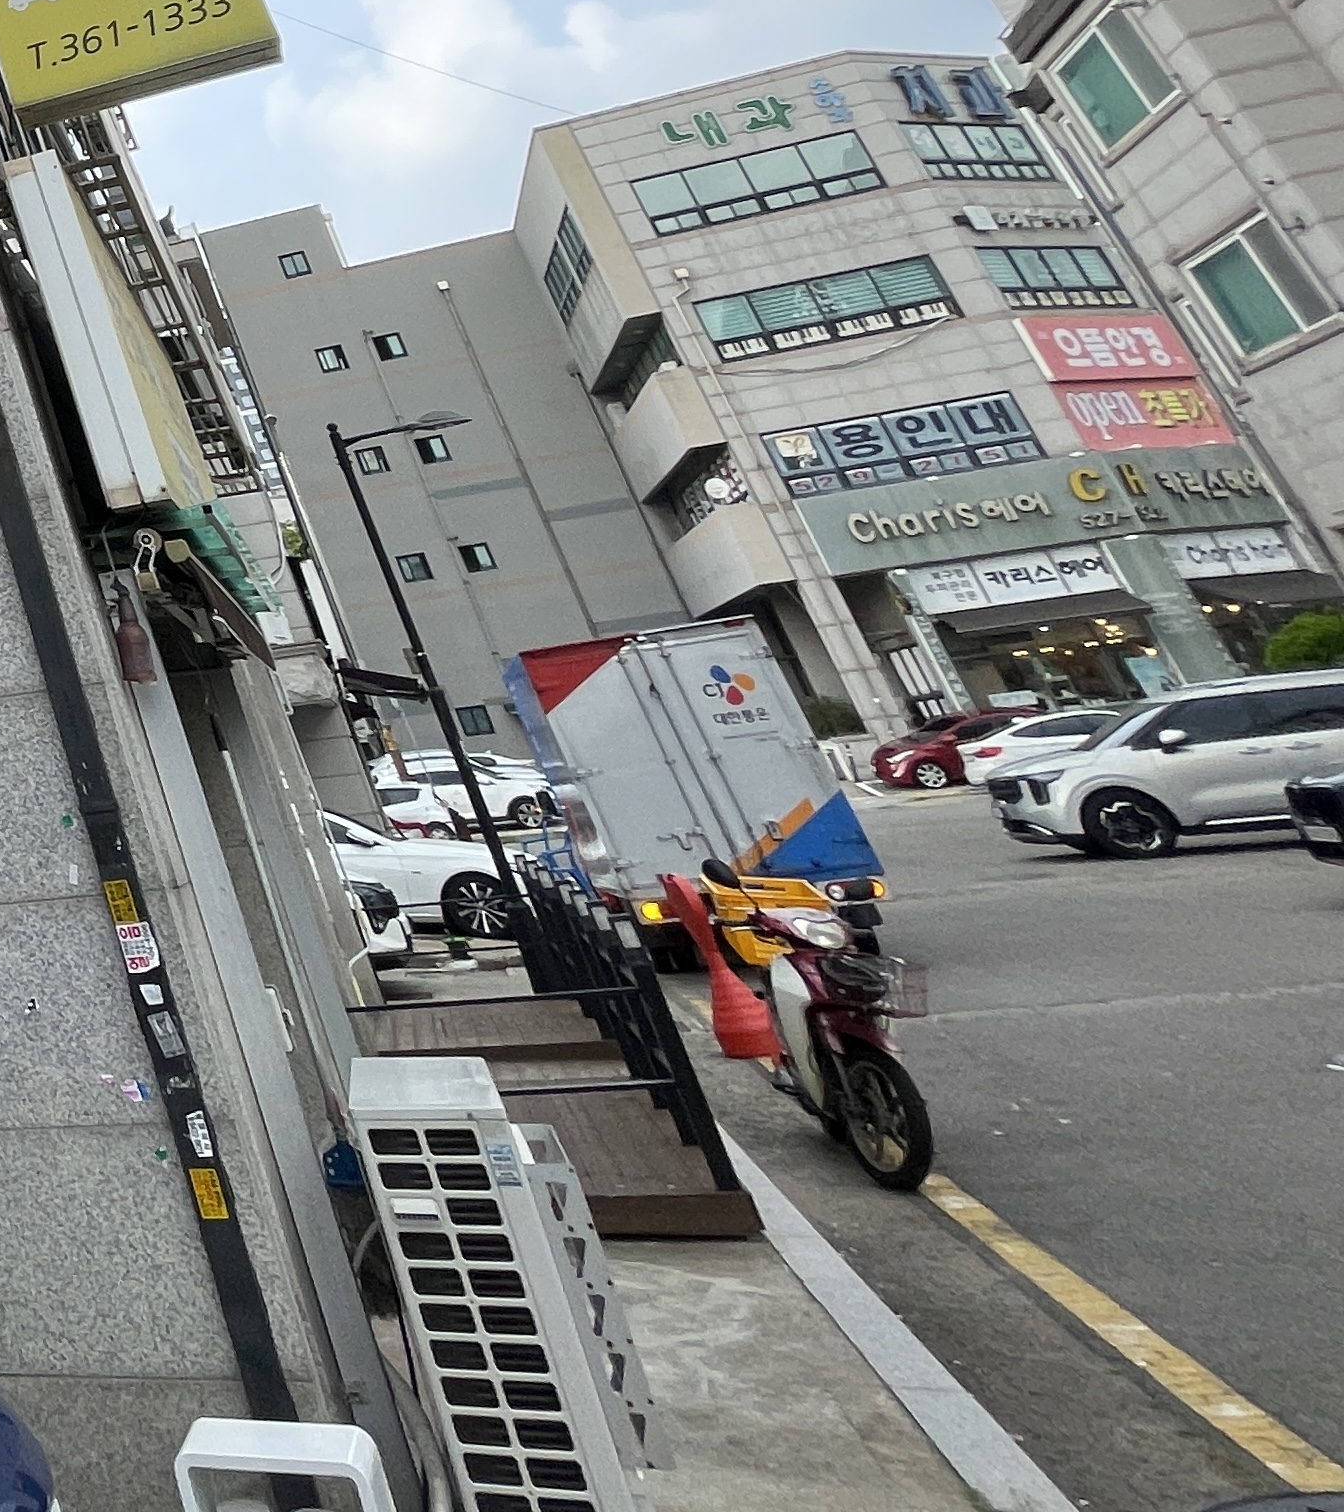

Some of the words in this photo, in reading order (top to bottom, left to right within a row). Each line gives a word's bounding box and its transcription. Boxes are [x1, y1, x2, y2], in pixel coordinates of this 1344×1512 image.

[661, 94, 794, 149] 내과
[1051, 326, 1172, 368] 으뜸안경
[831, 399, 1019, 460] 용인대
[1066, 389, 1148, 441] open
